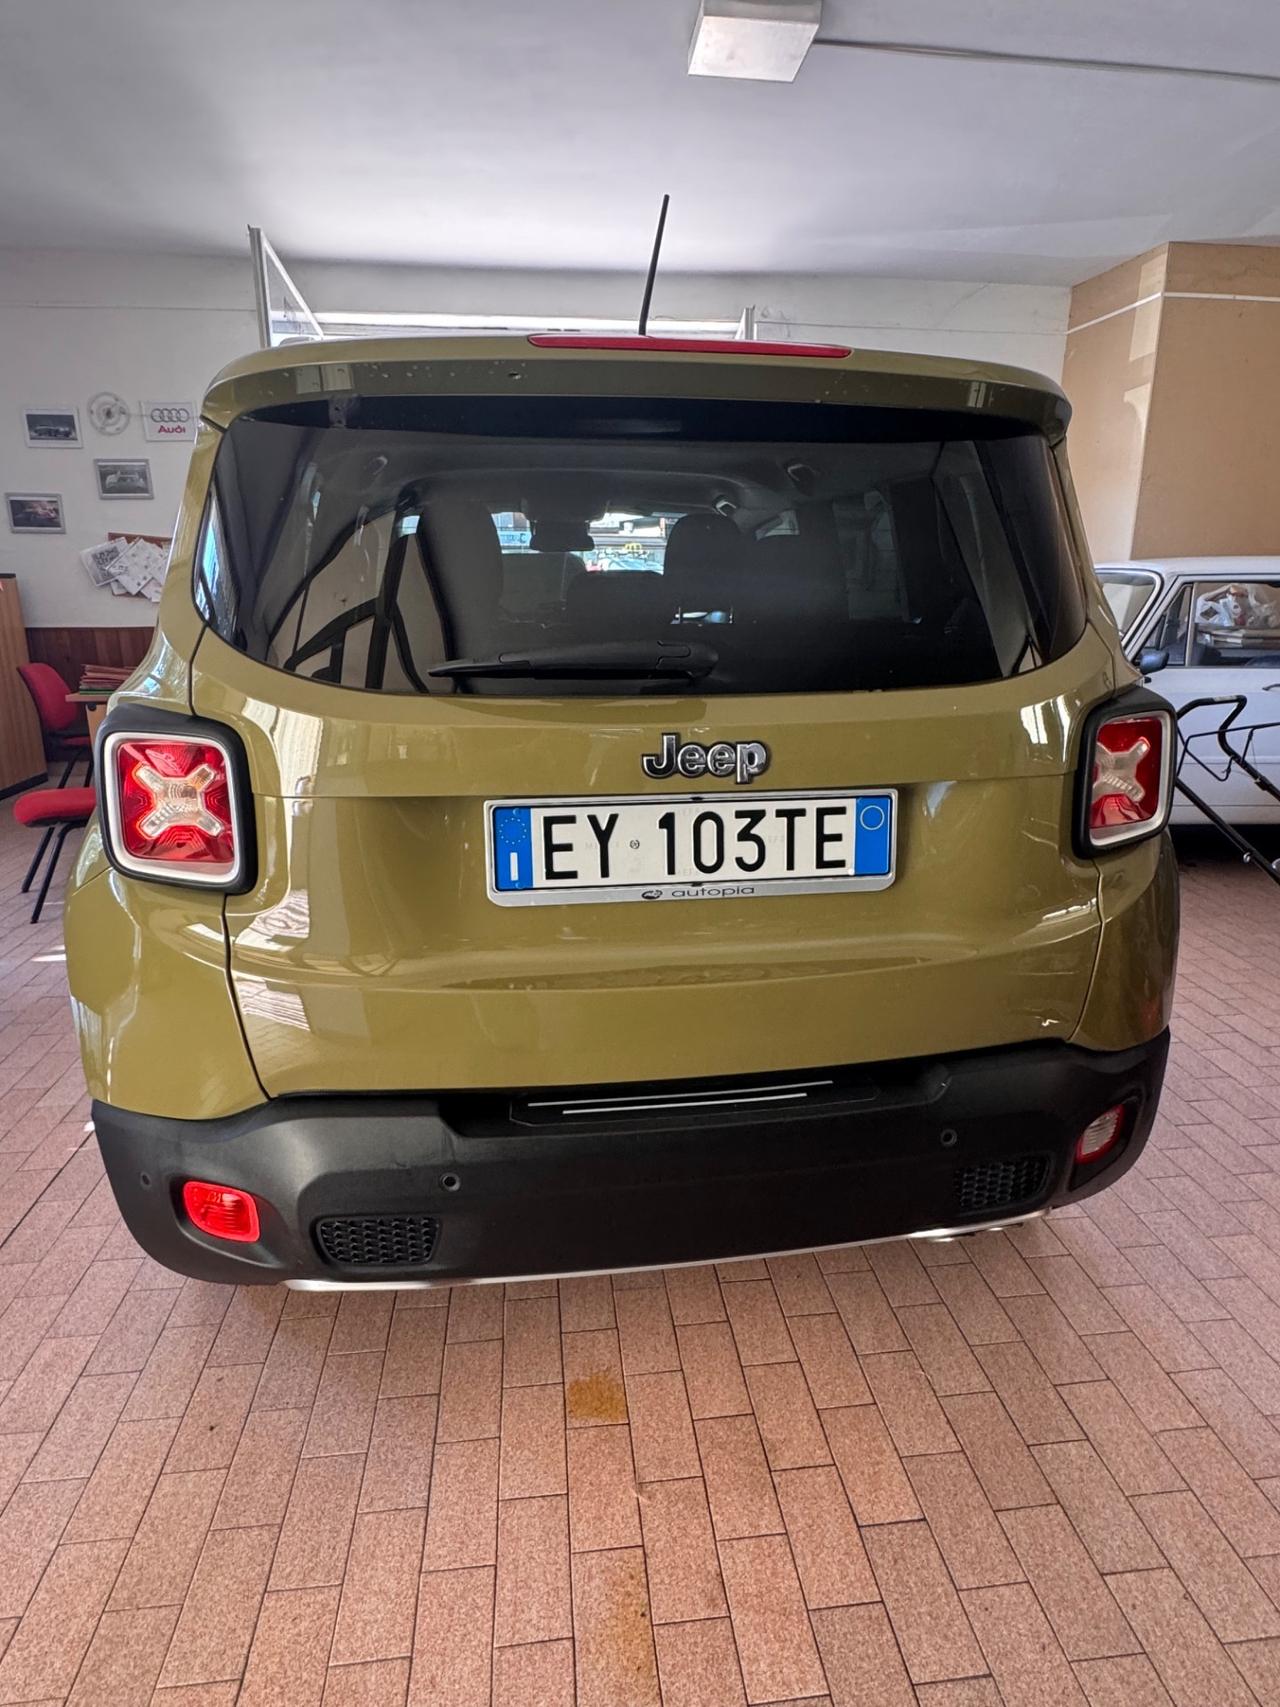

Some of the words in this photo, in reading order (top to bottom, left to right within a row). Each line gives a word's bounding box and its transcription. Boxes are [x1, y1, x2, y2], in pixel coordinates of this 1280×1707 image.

[158, 424, 186, 434] Audi
[641, 732, 770, 785] Jeep
[542, 813, 619, 881] EY
[658, 806, 847, 876] 103TE
[671, 885, 755, 899] autopia
